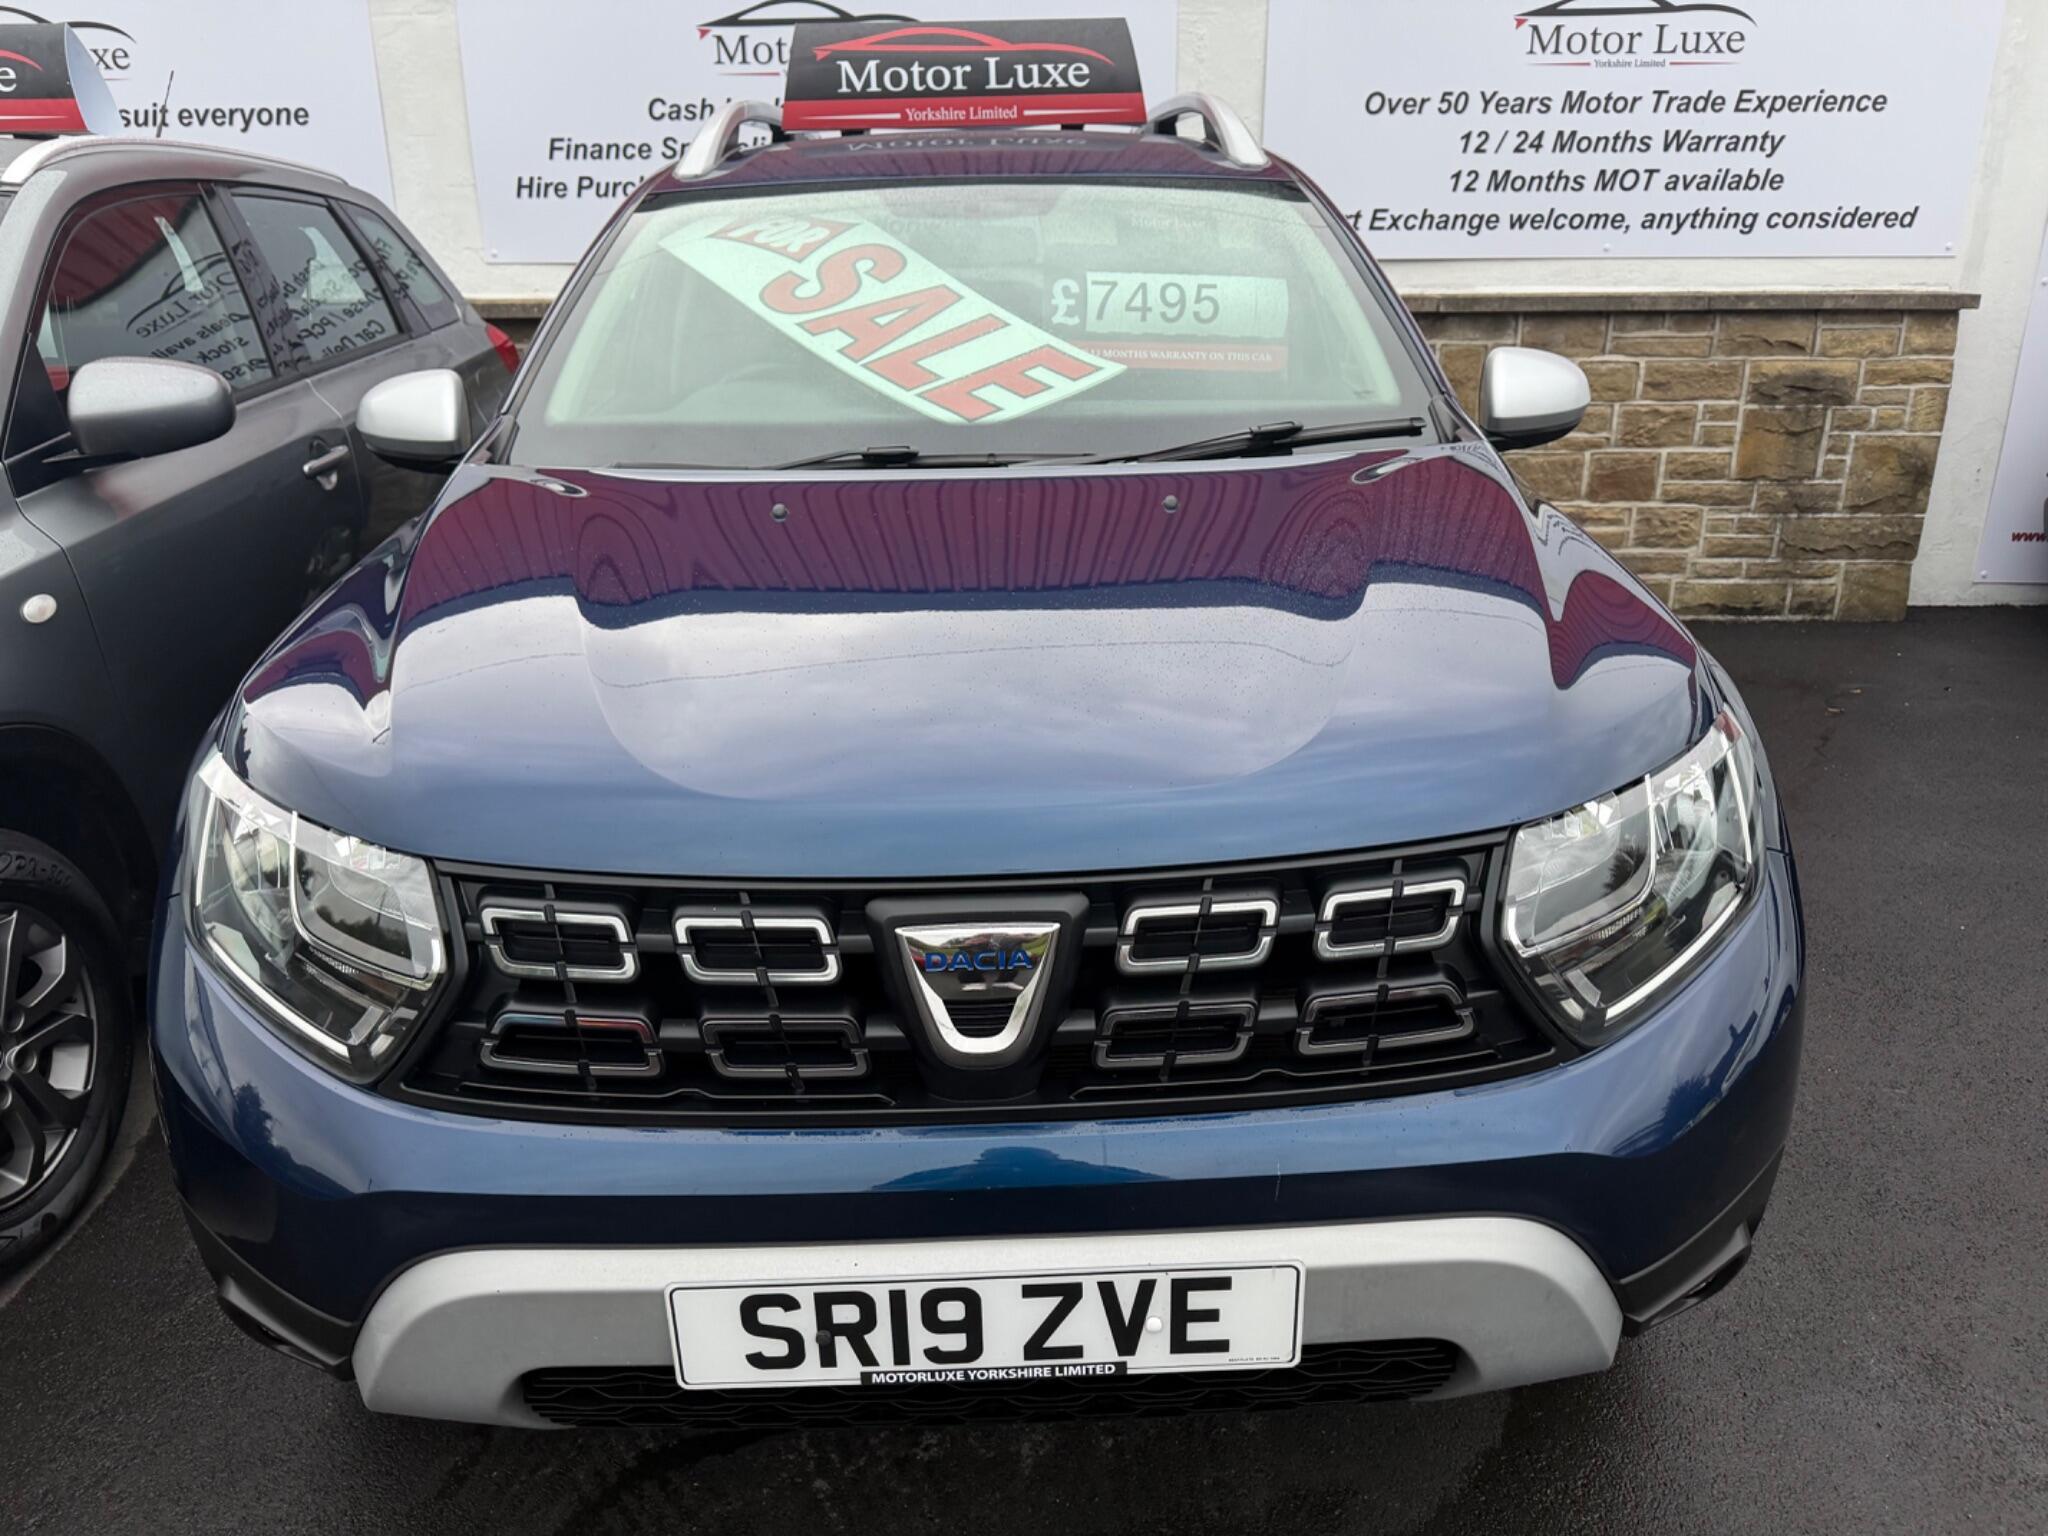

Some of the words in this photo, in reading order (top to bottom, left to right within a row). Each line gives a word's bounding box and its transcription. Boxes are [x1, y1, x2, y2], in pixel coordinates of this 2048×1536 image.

[713, 35, 788, 65] Mot
[1526, 24, 1643, 55] Motor
[1653, 24, 1746, 54] Luxe
[89, 47, 131, 70] xe
[1594, 59, 1632, 68] Yorkshire
[1634, 59, 1666, 68] Limited
[837, 59, 971, 93] Motor
[985, 56, 1090, 89] Luxe
[648, 98, 714, 121] Cash
[905, 107, 966, 121] Yorkshire
[969, 105, 1018, 120] Limited
[1365, 91, 1430, 115] Over
[1437, 91, 1470, 114] 50
[1480, 91, 1552, 114] Years
[1561, 90, 1643, 114] Motor
[1651, 90, 1726, 114] Trade
[1734, 89, 1888, 118] Experience
[119, 103, 169, 128] suit
[178, 105, 310, 132] everyone
[549, 137, 653, 160] Finance
[1460, 131, 1490, 153] 12
[1494, 131, 1509, 153] /
[1513, 130, 1544, 153] 24
[1552, 130, 1653, 153] Months
[1663, 129, 1787, 157] Warranty
[516, 176, 568, 198] Hire
[1450, 170, 1478, 192] 12
[1487, 169, 1585, 192] Months
[1594, 169, 1660, 191] MOT
[1665, 168, 1785, 191] available
[1369, 208, 1500, 235] Exchange
[1509, 208, 1632, 234] welcome,
[1641, 206, 1759, 234] anything
[1766, 206, 1920, 229] considered
[727, 216, 831, 252] FOR
[758, 243, 1106, 423] SALE
[1102, 349, 1149, 359] MONTHS
[1150, 350, 1208, 361] WARRANTY
[1209, 351, 1225, 361] ON
[1227, 351, 1250, 361] THIS
[1251, 352, 1273, 362] CAR
[924, 950, 1033, 972] DACIA
[739, 1286, 984, 1370] SR19
[1021, 1276, 1233, 1361] ZVE
[871, 1371, 965, 1384] MOTORLUXE
[968, 1367, 1051, 1381] YORKSHIRE
[1055, 1364, 1116, 1377] LIMITED
